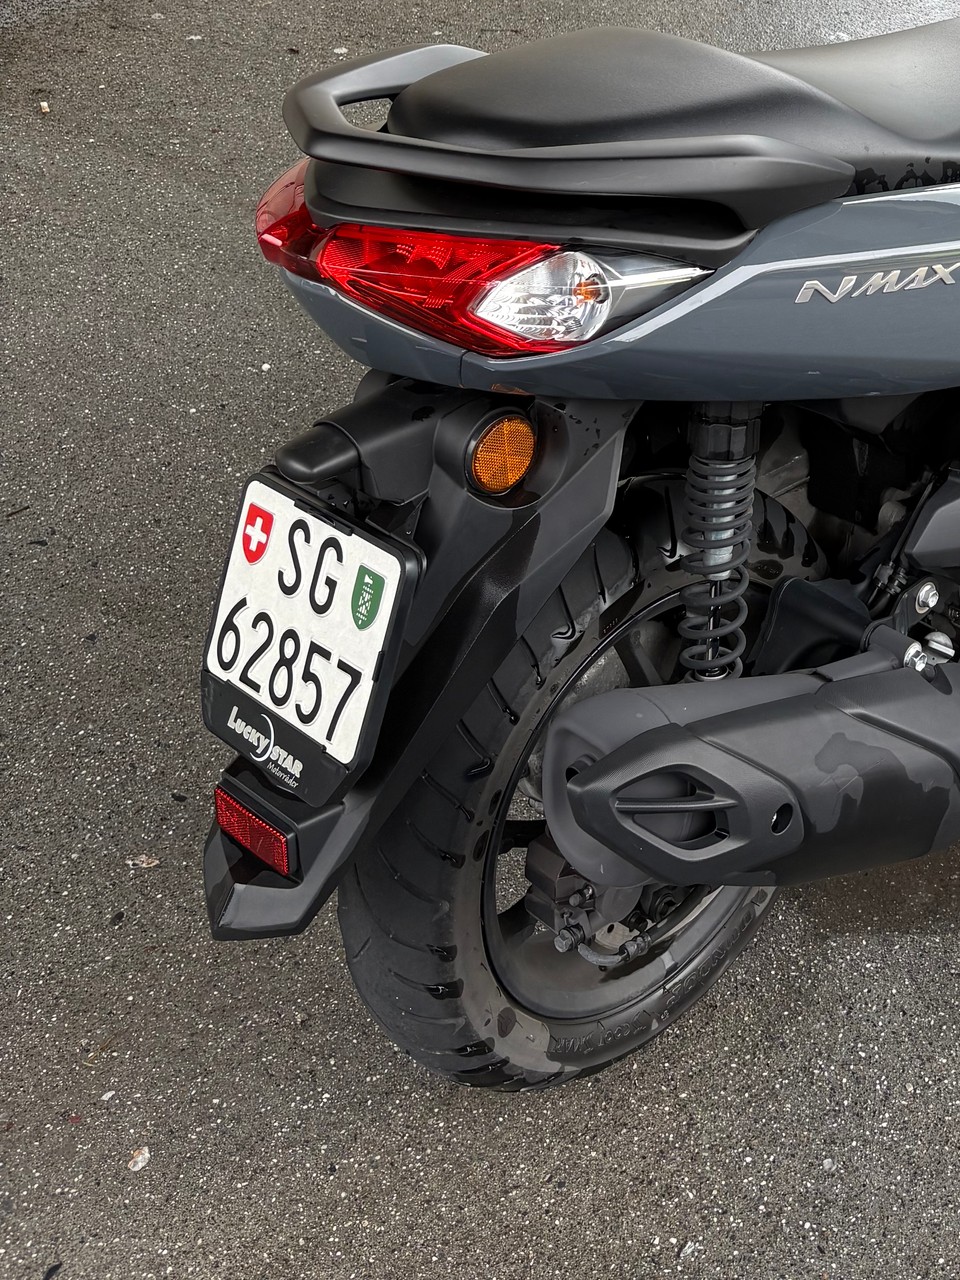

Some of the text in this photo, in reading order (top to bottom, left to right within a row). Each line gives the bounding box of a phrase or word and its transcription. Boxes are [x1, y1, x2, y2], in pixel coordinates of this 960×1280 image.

[277, 518, 344, 617] SG
[216, 596, 362, 743] 62857
[269, 745, 304, 778] STAR
